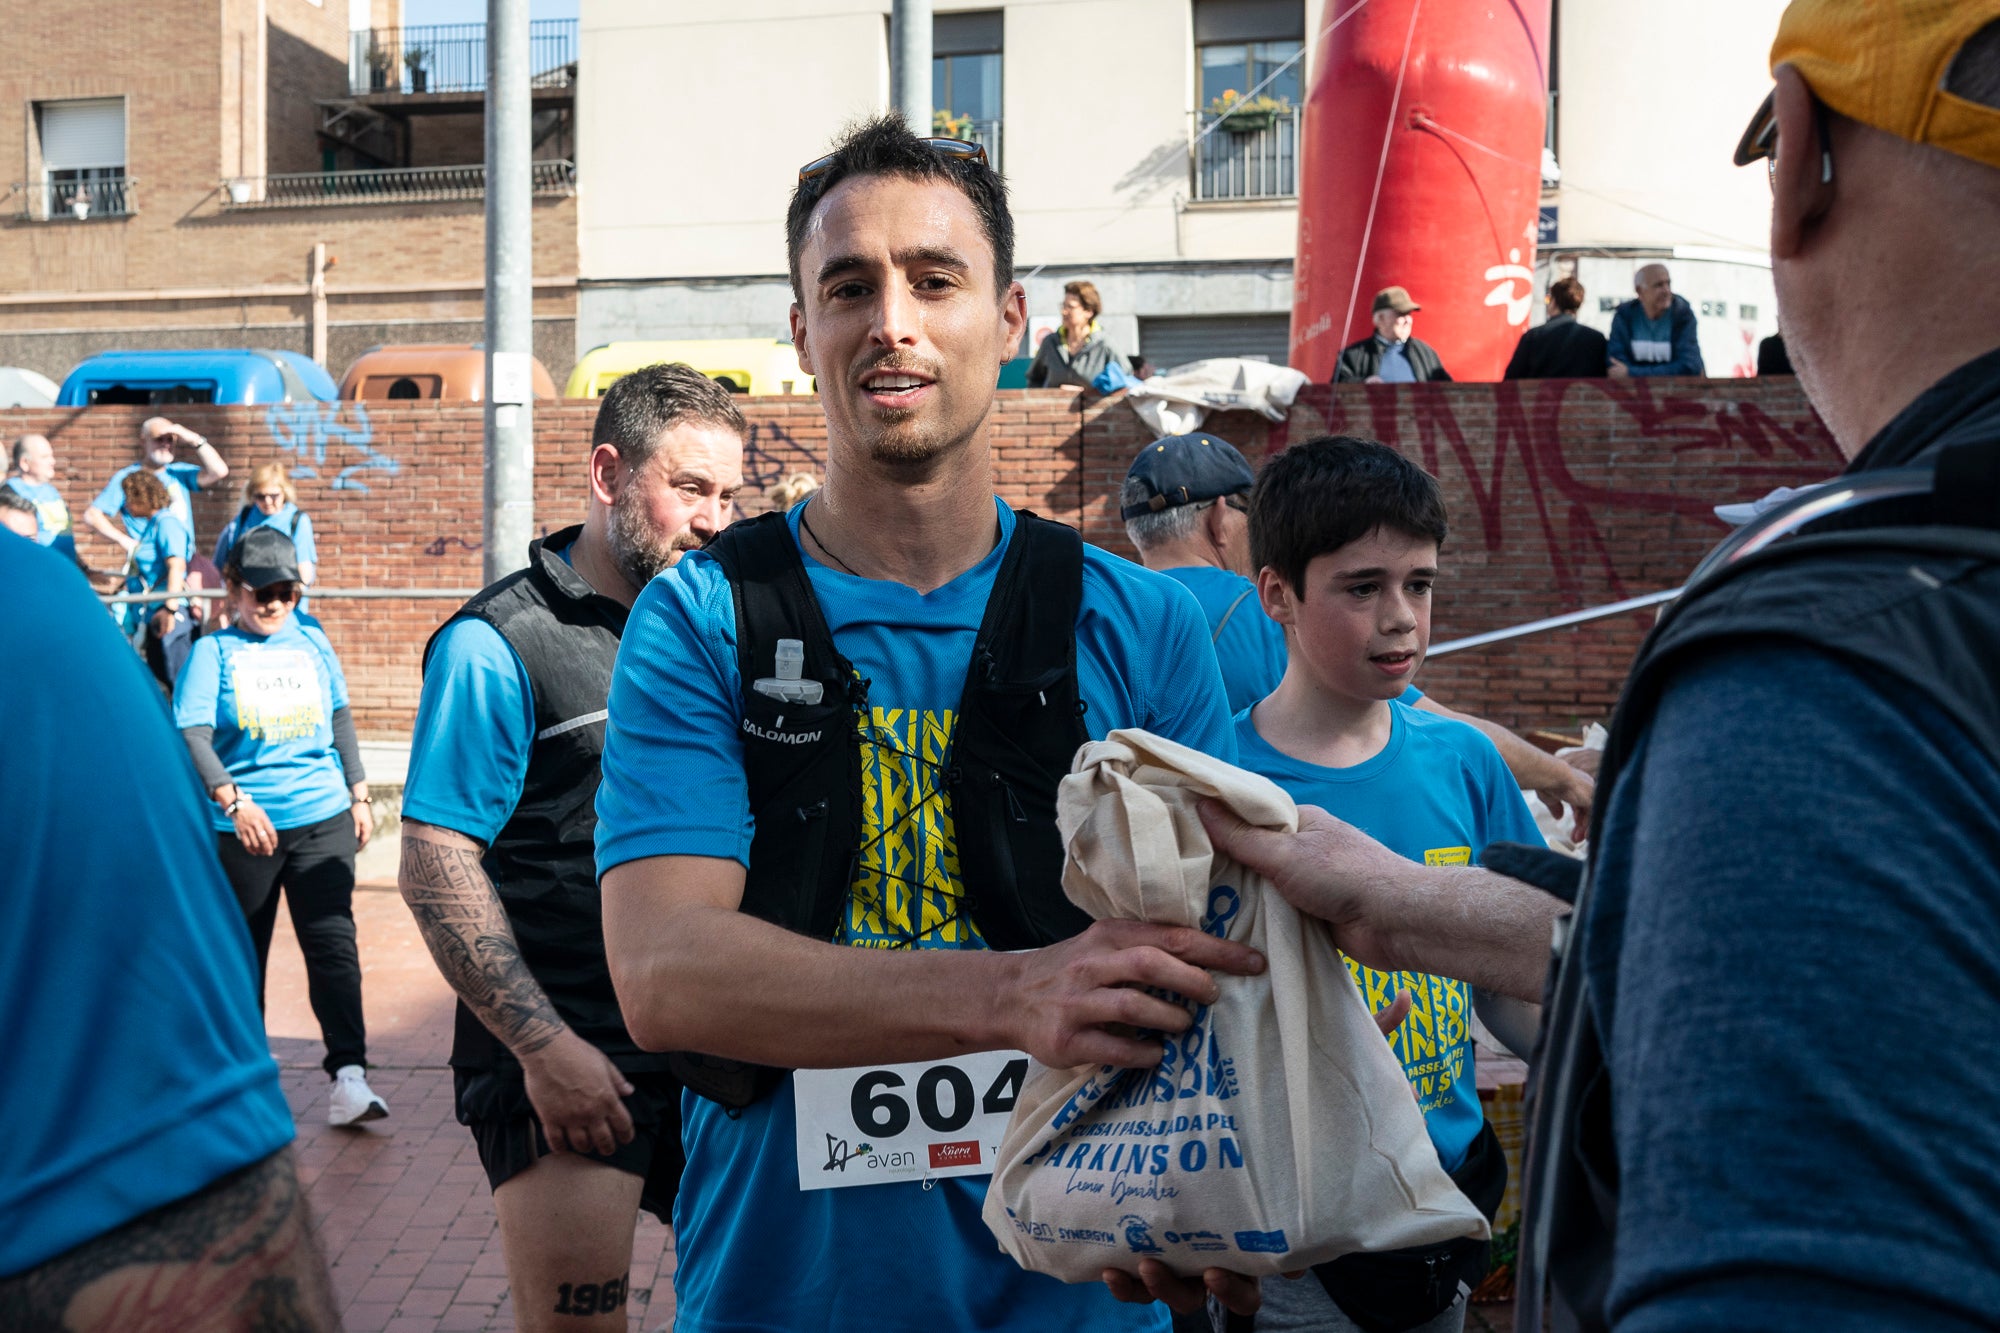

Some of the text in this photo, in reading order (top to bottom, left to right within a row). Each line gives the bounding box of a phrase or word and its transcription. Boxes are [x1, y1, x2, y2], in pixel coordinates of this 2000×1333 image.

[742, 718, 822, 745] SALOMON
[1221, 1057, 1240, 1097] 2025
[850, 1058, 1029, 1139] 604
[867, 1151, 915, 1169] avan
[1022, 1136, 1244, 1176] PARKINSON
[1058, 1227, 1116, 1244] SYNERGYM
